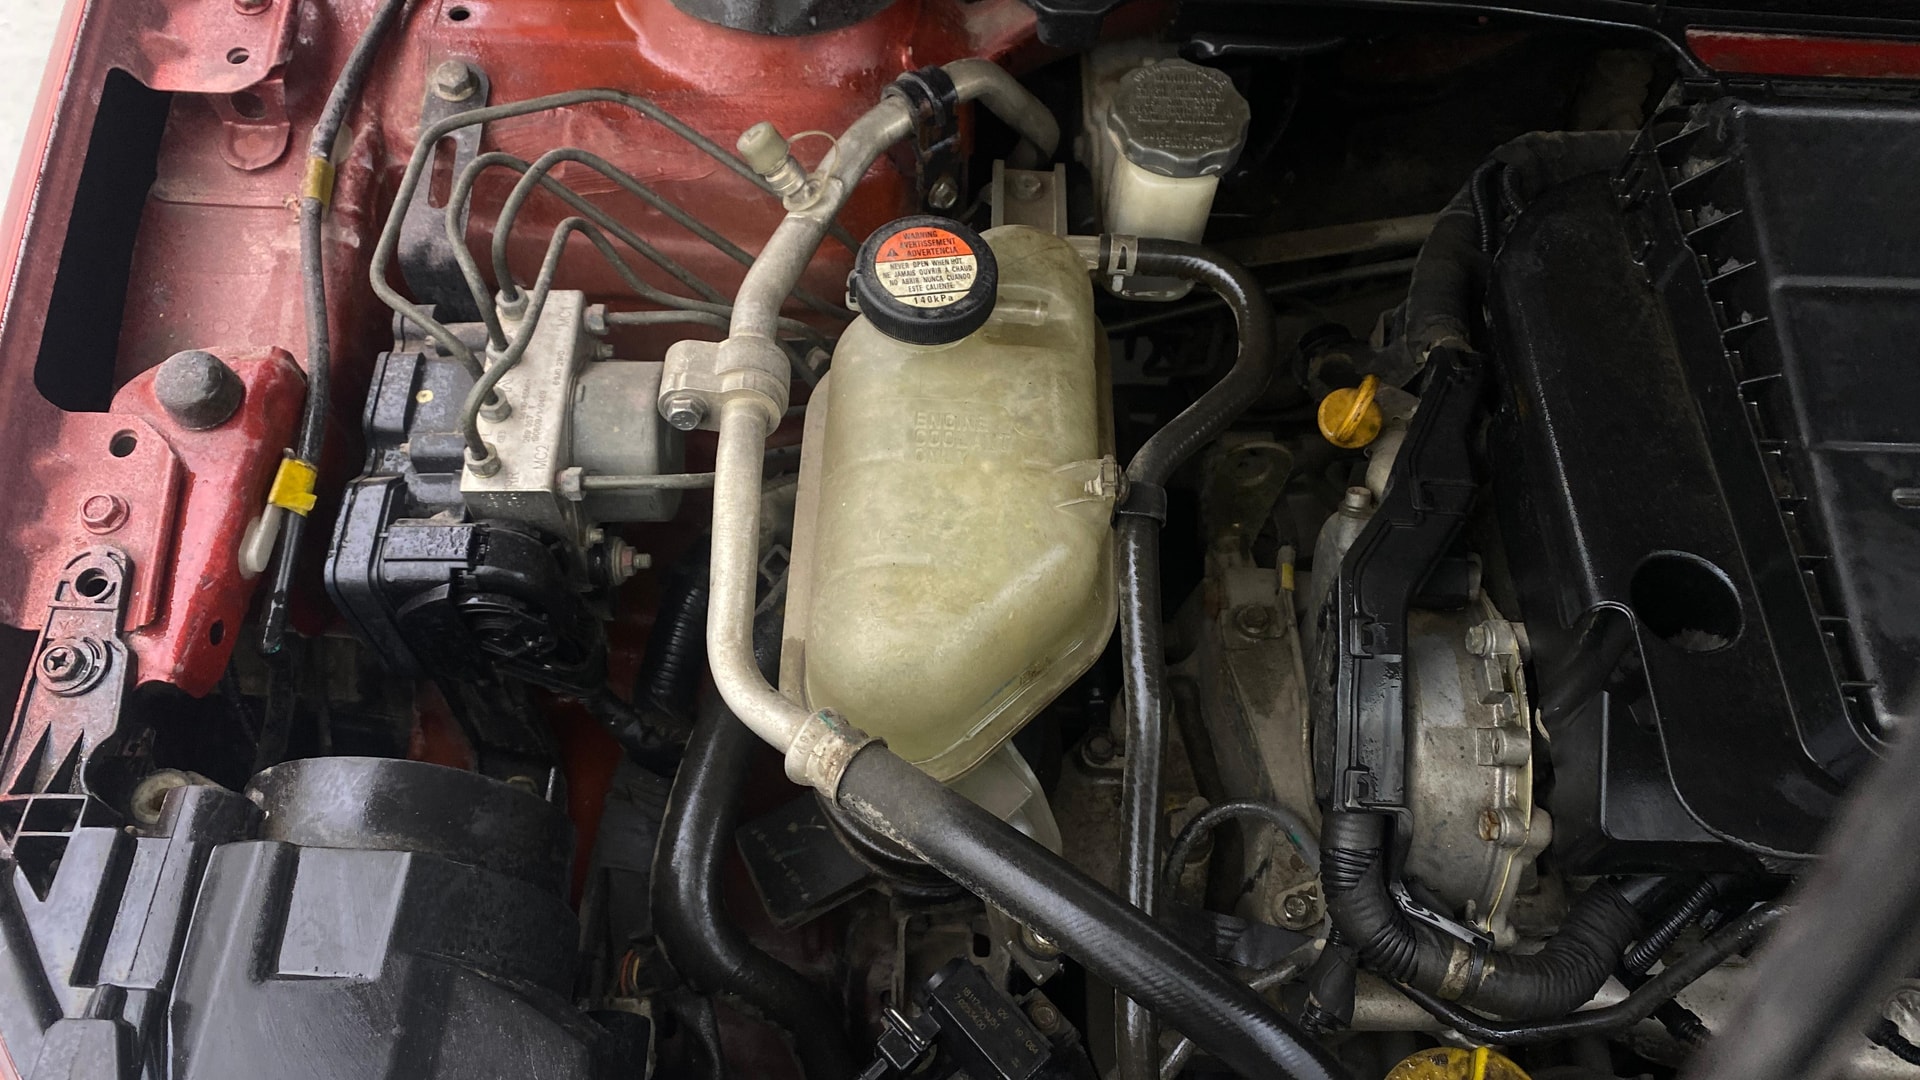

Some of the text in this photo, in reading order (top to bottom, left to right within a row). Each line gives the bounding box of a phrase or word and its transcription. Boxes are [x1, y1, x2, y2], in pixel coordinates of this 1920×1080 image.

[903, 231, 938, 239] WARNING
[906, 247, 958, 256] ADVERTENCIA
[894, 270, 916, 278] JAMAIS
[902, 277, 920, 285] ABRIR
[923, 275, 944, 283] NUNCA
[947, 273, 971, 281] CUANDO
[914, 411, 989, 433] ENGINE
[914, 429, 1011, 453] COOLANT
[533, 443, 549, 470] MC2
